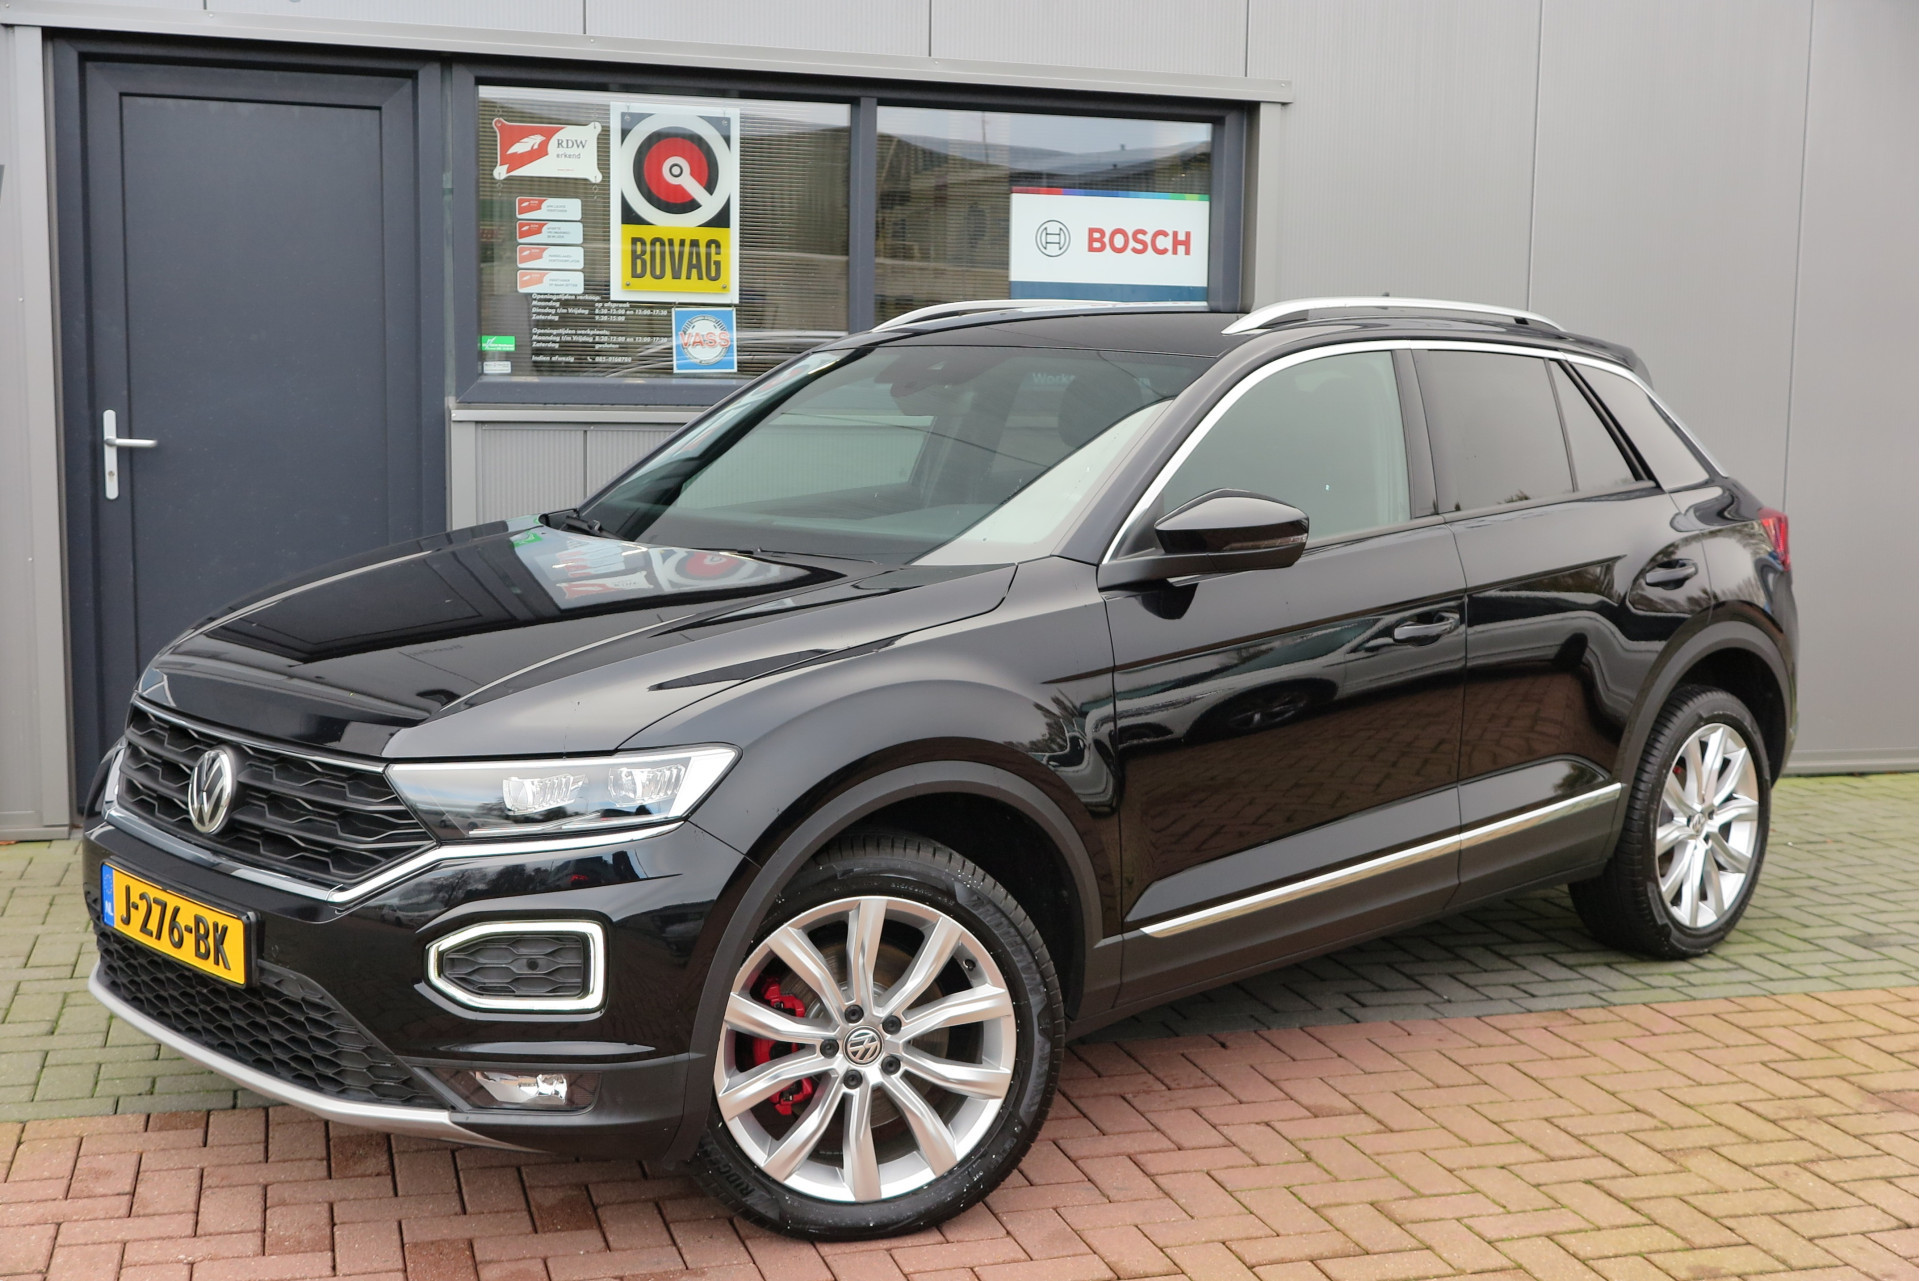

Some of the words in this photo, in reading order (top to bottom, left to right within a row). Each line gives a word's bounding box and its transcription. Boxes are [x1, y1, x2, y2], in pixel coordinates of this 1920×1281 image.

[557, 139, 588, 149] RDW
[1087, 227, 1192, 256] BOSCH
[631, 237, 721, 281] BOVAG
[531, 293, 576, 301] Openingstijden
[531, 341, 559, 349] Zaterdag
[678, 331, 731, 348] VASS
[104, 900, 114, 917] NL
[120, 884, 231, 971] J-276-BK
